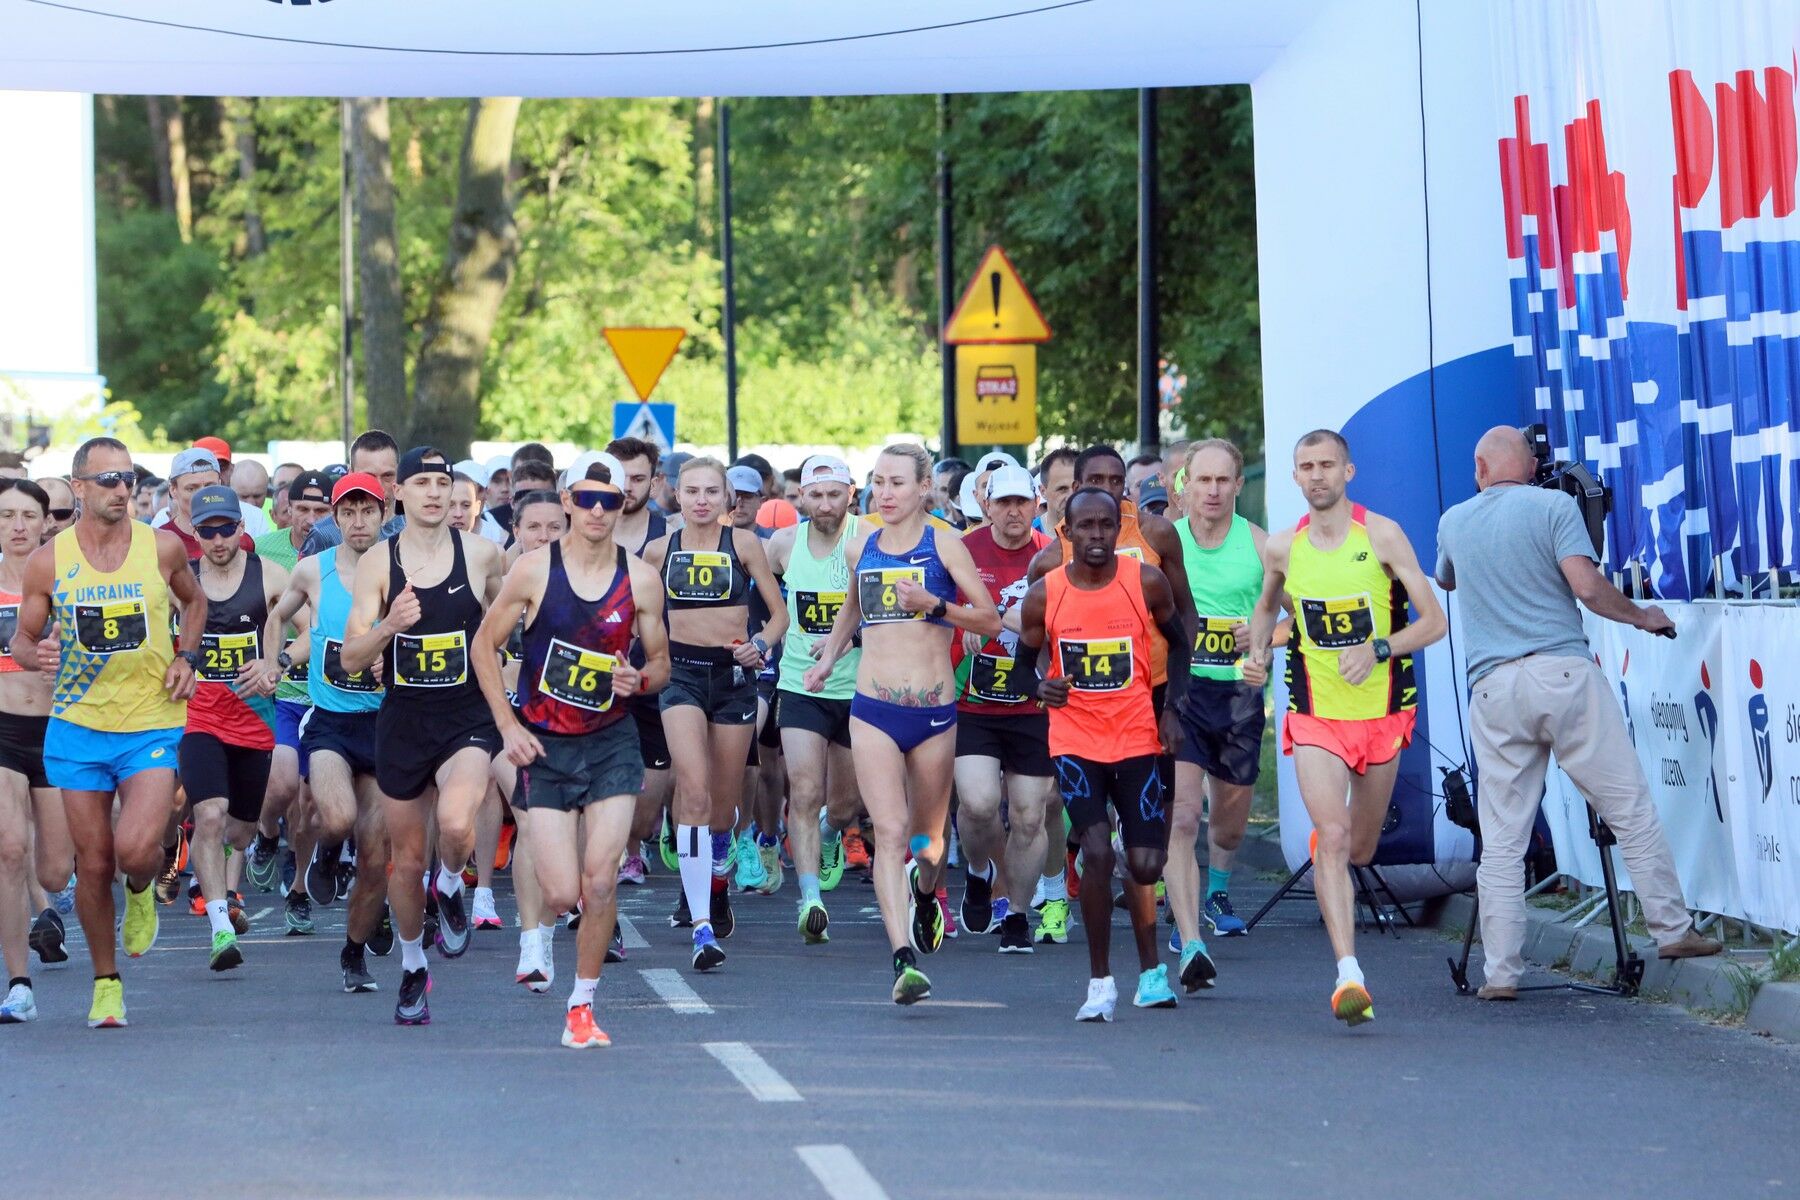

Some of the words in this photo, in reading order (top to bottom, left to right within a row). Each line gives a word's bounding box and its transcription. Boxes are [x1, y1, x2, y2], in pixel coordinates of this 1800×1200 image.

[687, 567, 712, 586] 10
[76, 583, 144, 602] UKRAINE
[882, 586, 896, 607] 6
[103, 619, 119, 639] 8
[1321, 613, 1352, 635] 13
[205, 649, 244, 668] 251
[416, 651, 446, 672] 15
[1081, 656, 1111, 676] 14
[568, 665, 597, 692] 16
[993, 671, 1007, 687] 2
